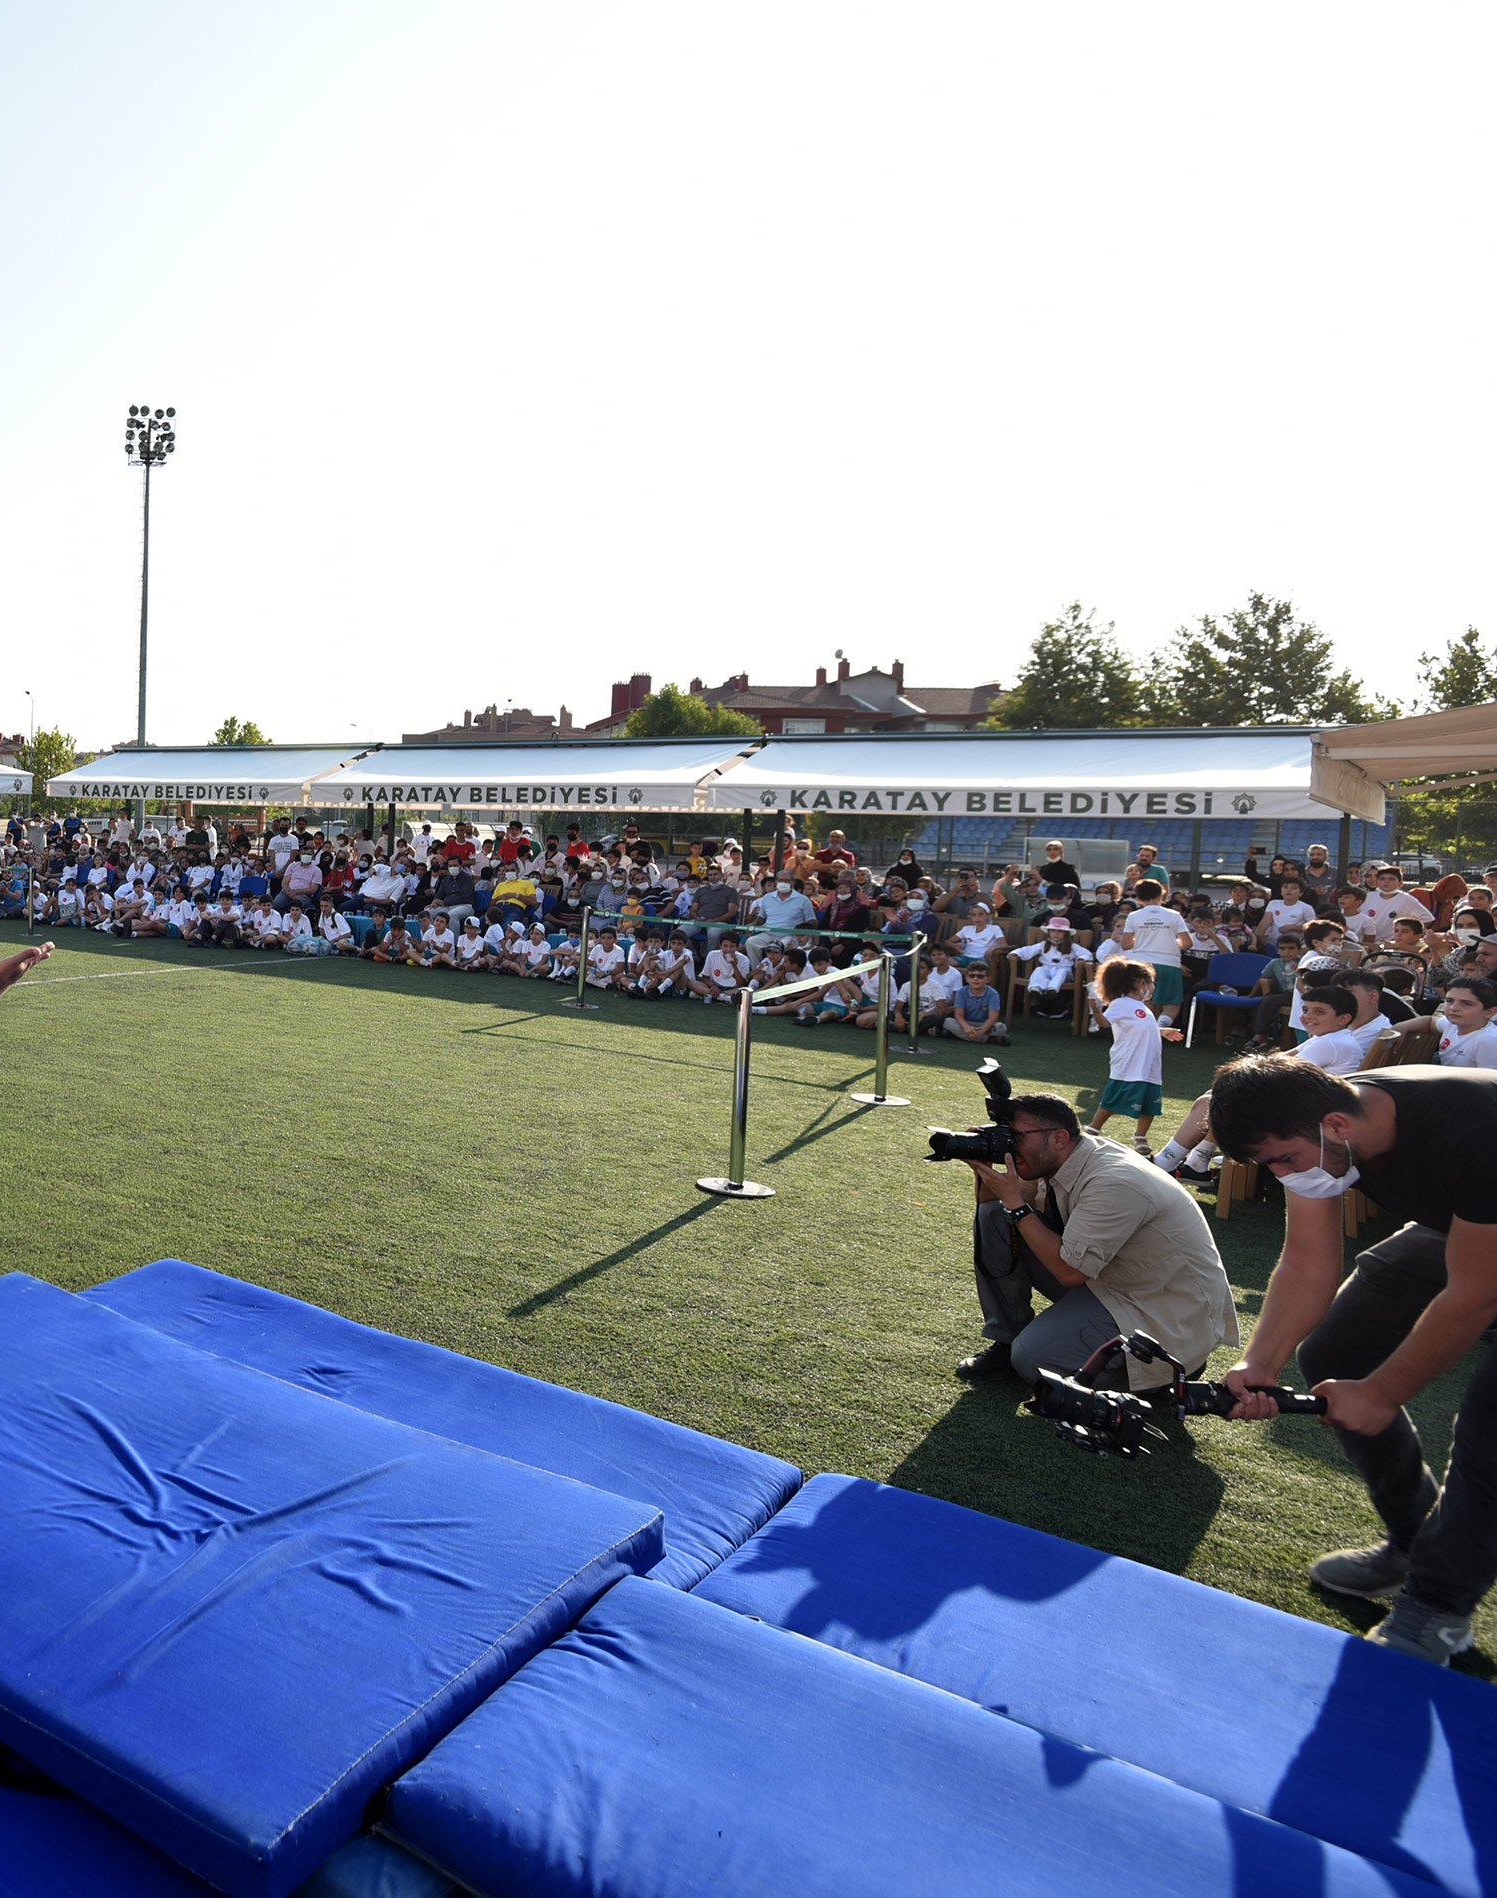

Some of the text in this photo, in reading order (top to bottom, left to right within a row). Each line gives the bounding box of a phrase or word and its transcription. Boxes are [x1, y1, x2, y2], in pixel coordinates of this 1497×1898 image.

[81, 784, 150, 798] KARATAY
[361, 786, 463, 803] KARATAY
[789, 789, 952, 812] KARATAY
